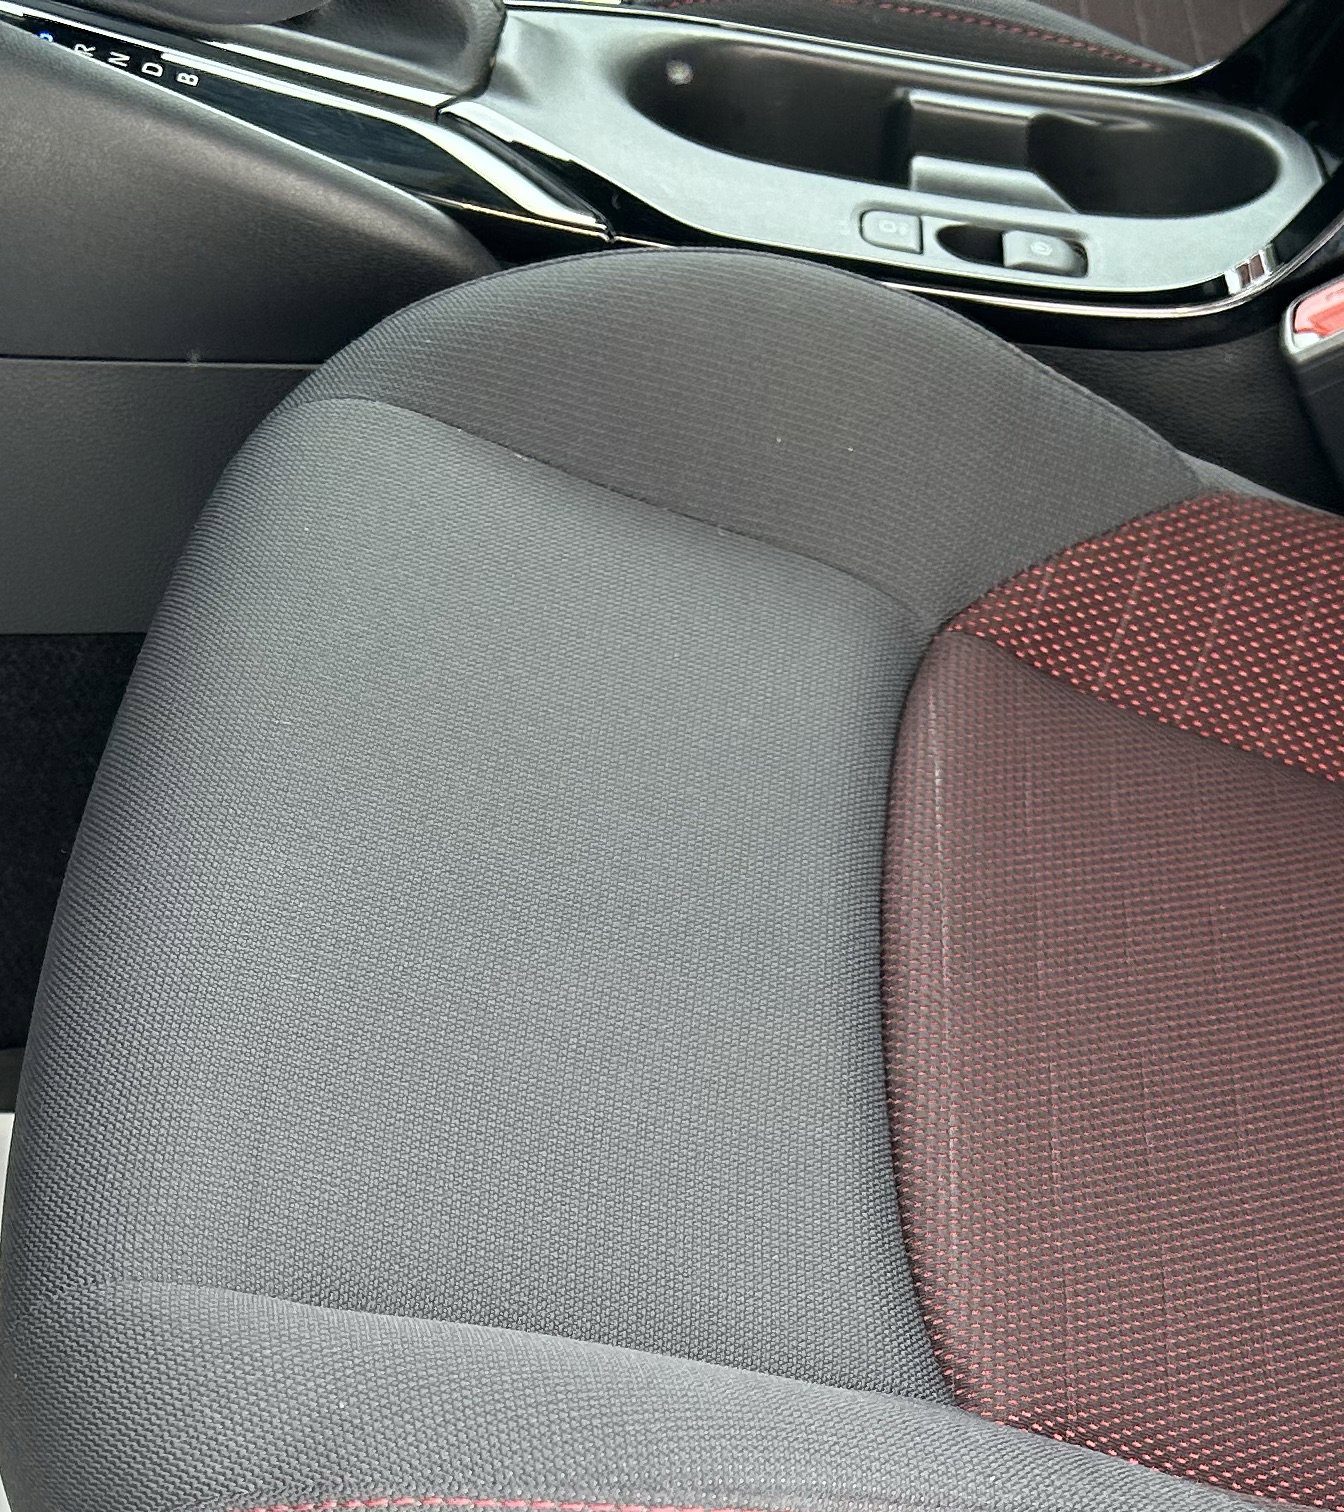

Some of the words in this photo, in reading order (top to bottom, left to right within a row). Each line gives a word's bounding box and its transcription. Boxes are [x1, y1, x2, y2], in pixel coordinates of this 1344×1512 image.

[108, 51, 131, 68] N
[141, 61, 164, 79] D
[176, 71, 200, 88] B
